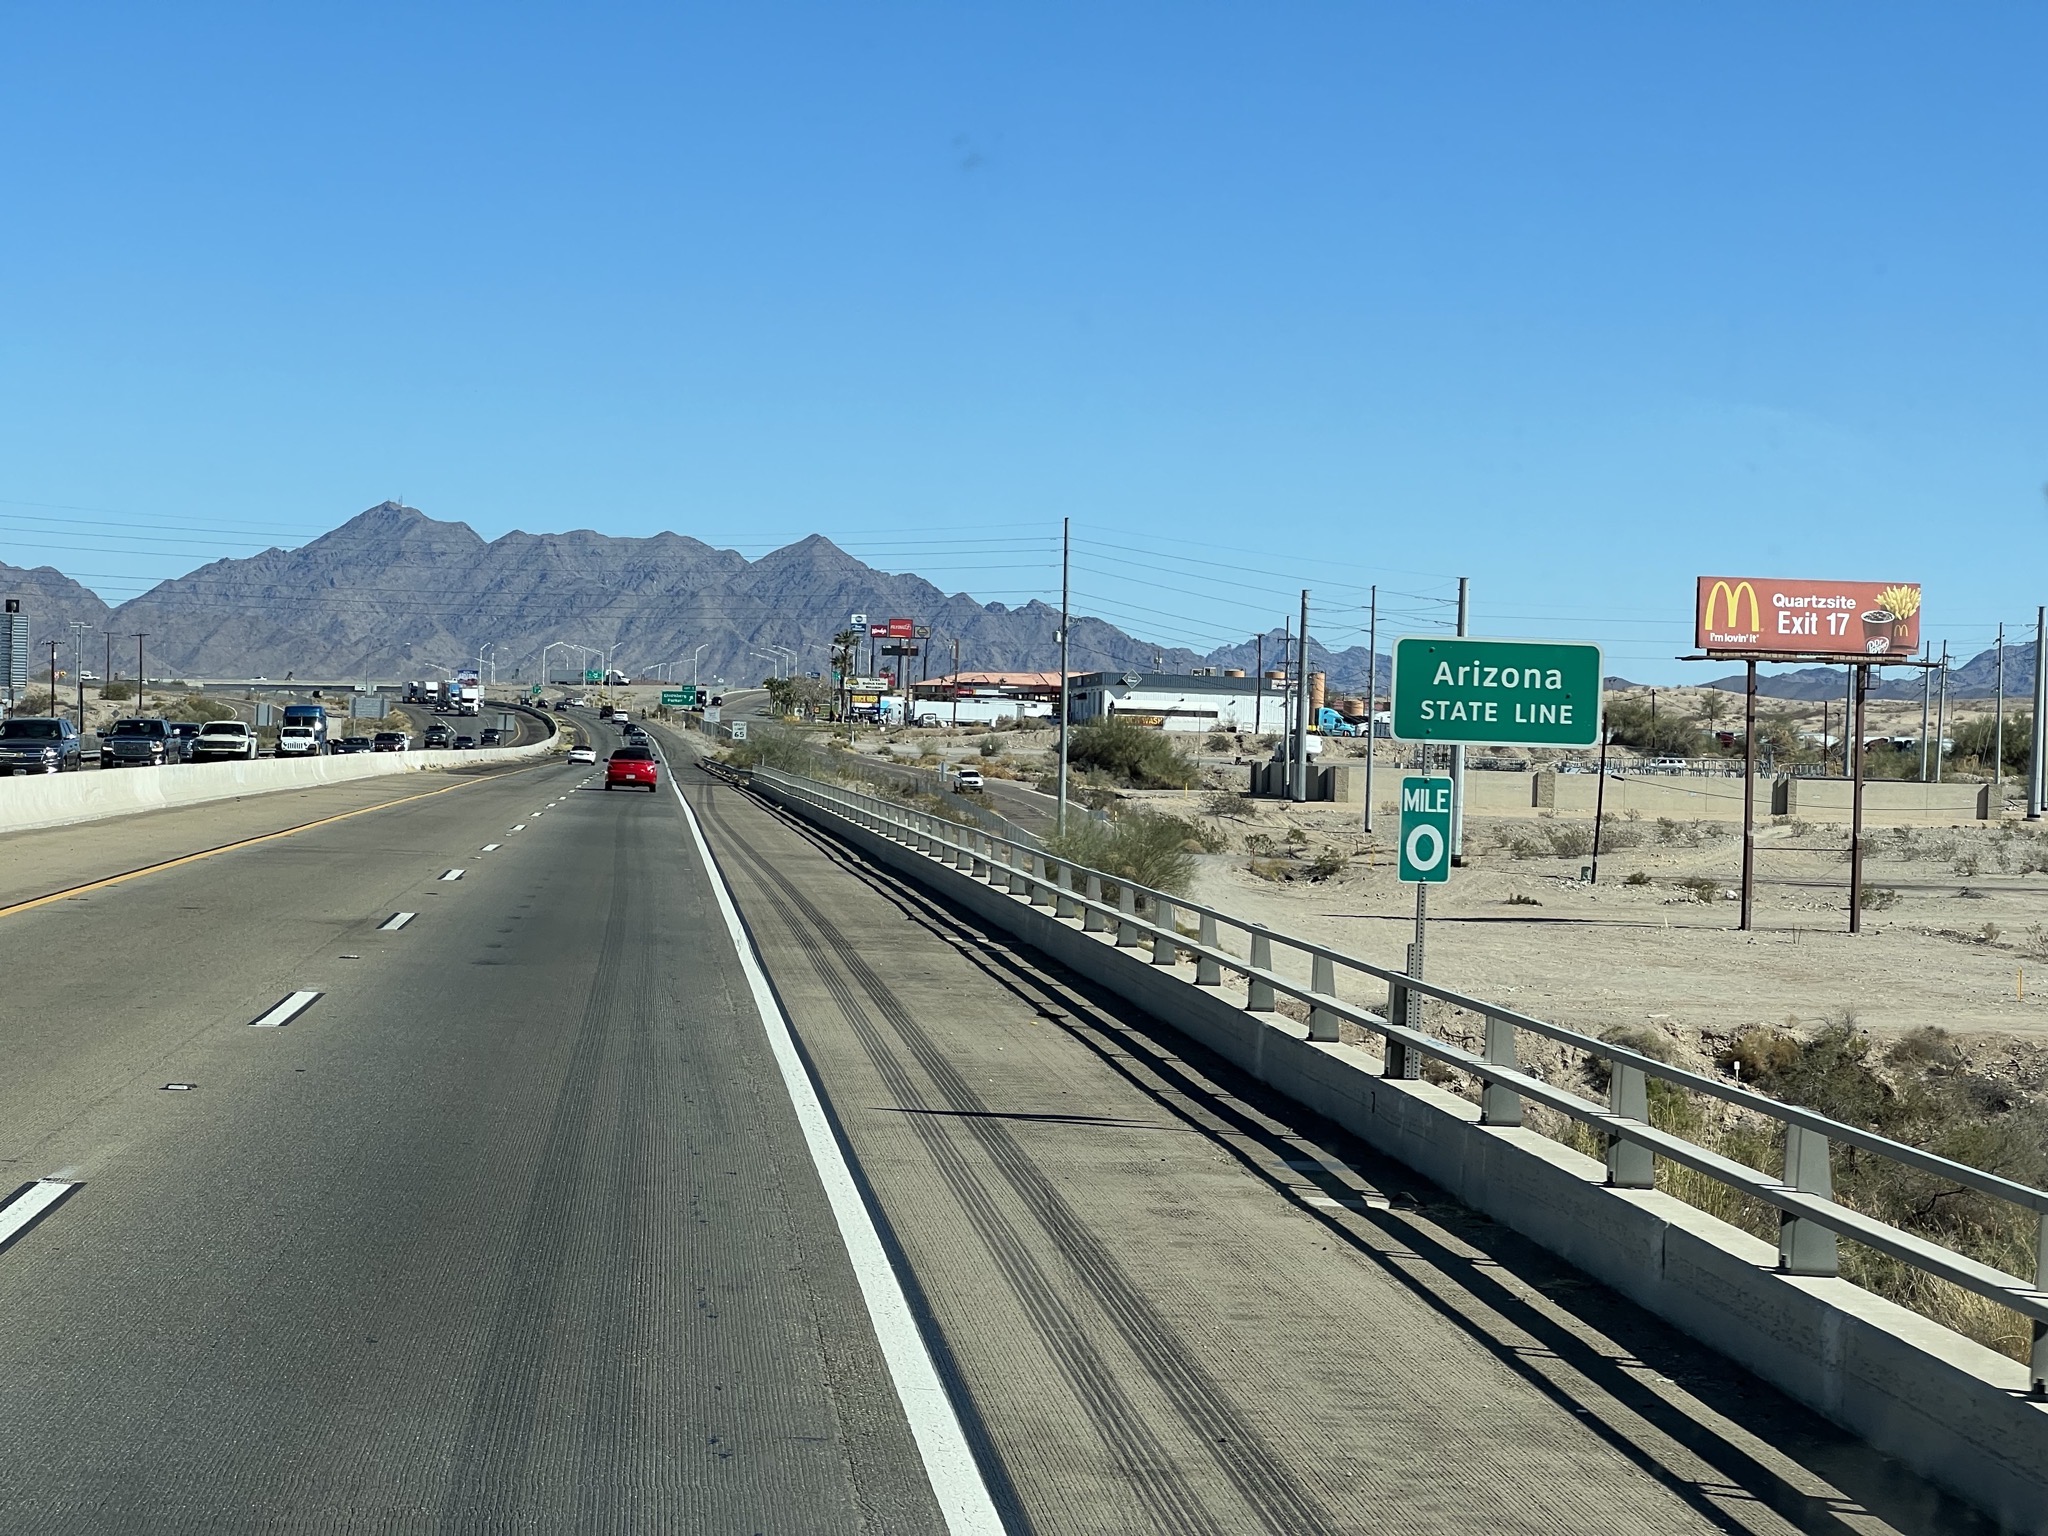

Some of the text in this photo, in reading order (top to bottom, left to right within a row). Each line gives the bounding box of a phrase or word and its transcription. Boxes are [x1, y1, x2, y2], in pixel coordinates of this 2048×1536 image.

[1772, 593, 1857, 610] Quartzsite
[1777, 611, 1850, 636] Exit 17
[1709, 633, 1723, 642] I'm
[1724, 633, 1749, 643] lovin'
[1432, 660, 1562, 690] Arizona
[1142, 717, 1163, 725] WASH
[1420, 700, 1573, 725] STATE LINE
[1404, 788, 1449, 813] MILE
[1405, 823, 1444, 872] 0
